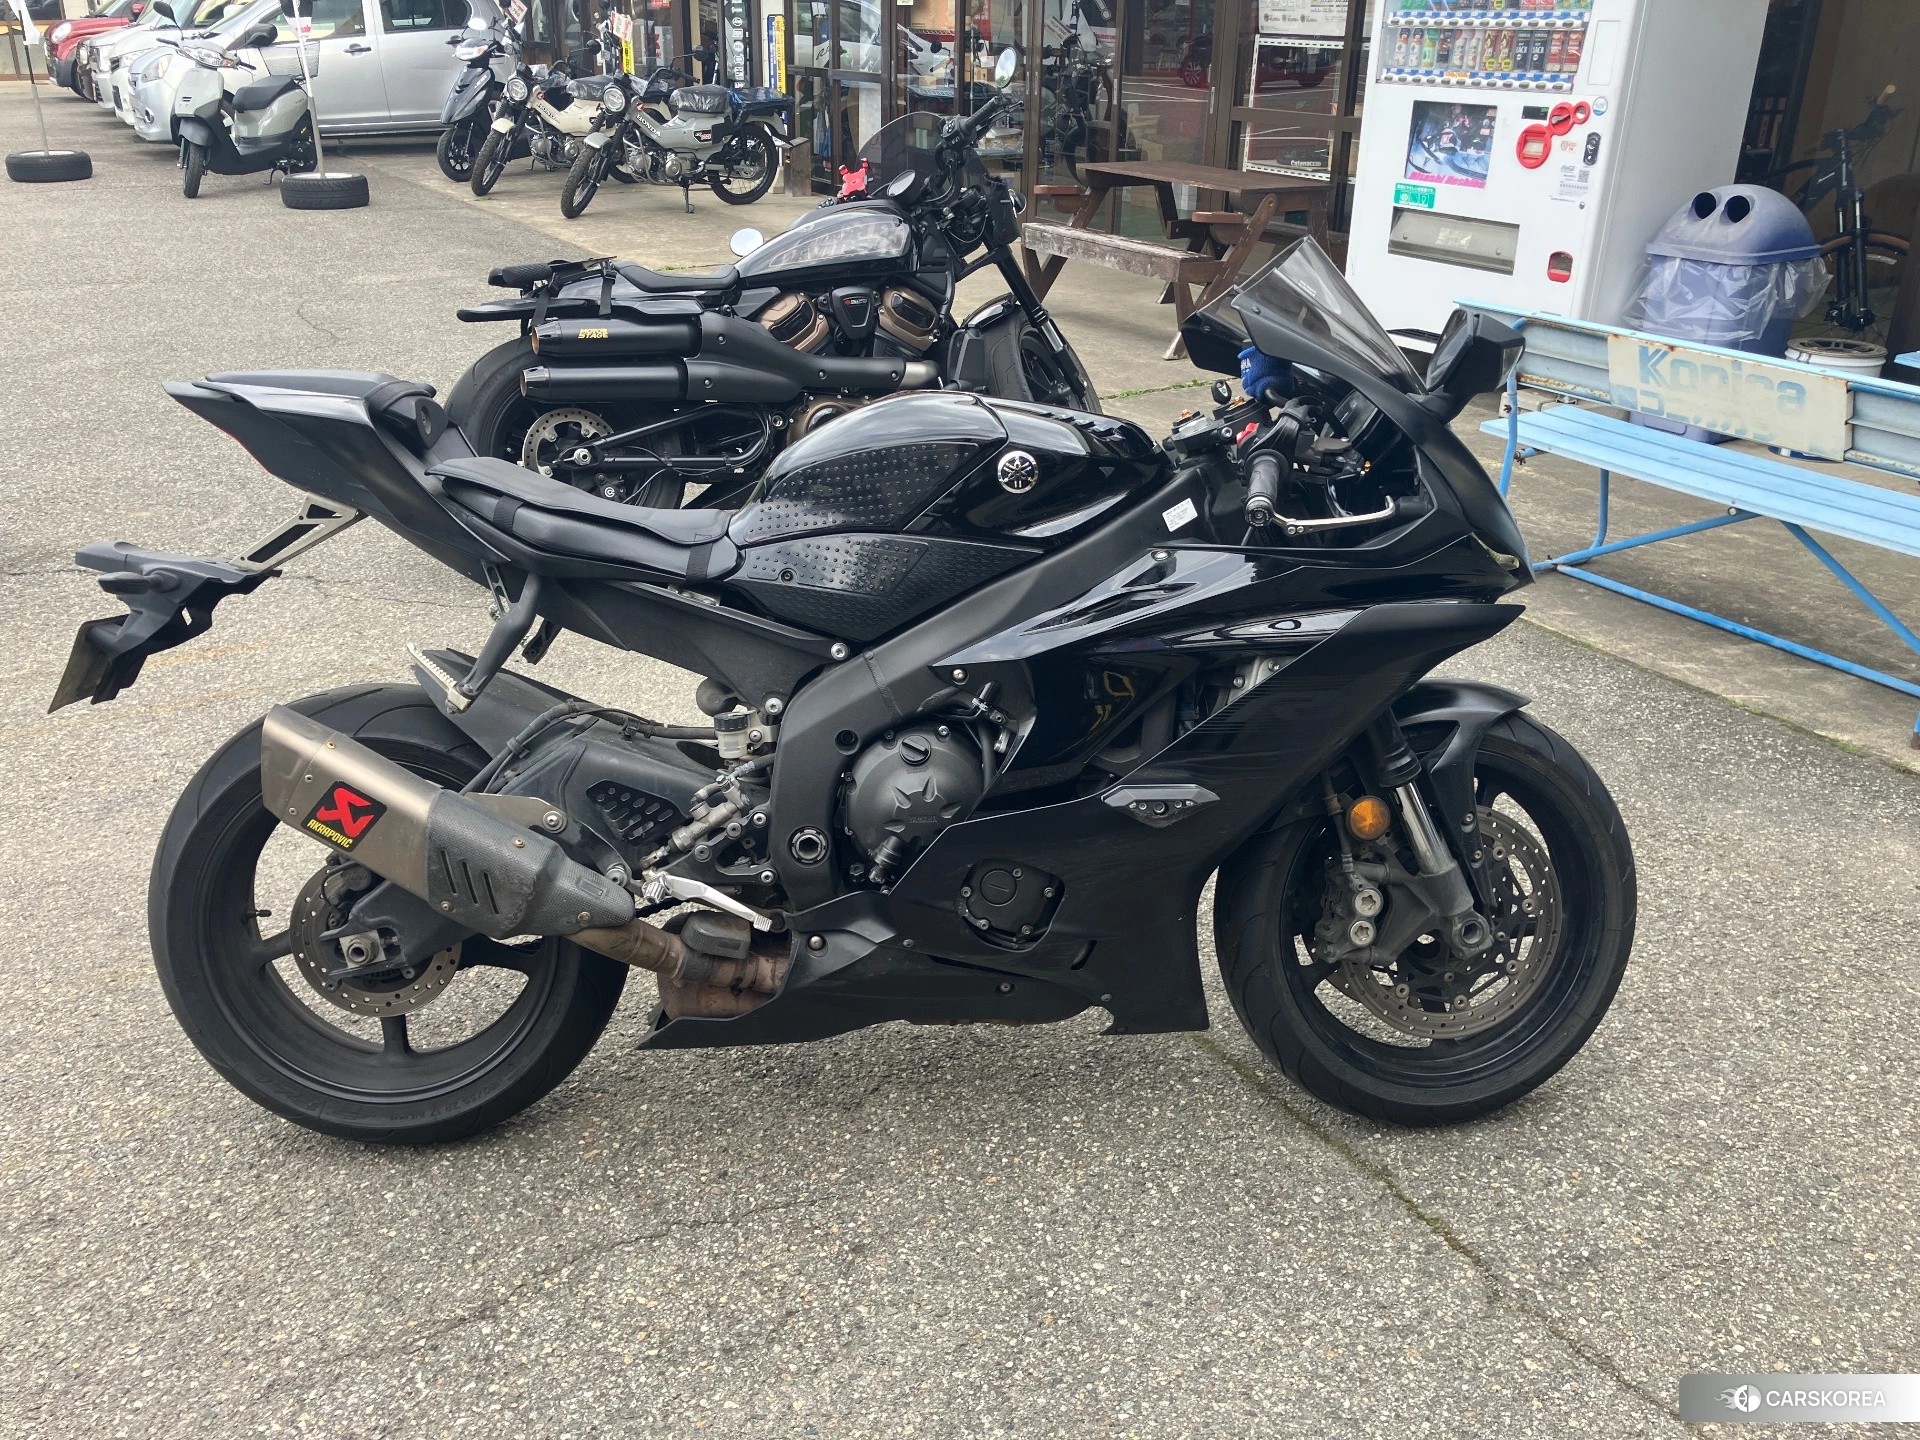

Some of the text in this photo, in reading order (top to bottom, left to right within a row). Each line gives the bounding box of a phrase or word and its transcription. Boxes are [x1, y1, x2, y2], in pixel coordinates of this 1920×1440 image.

[537, 102, 561, 123] HONDA
[636, 113, 662, 138] HONDA
[1638, 344, 1807, 416] Konica
[908, 815, 938, 824] YAMAHA
[306, 819, 354, 848] AKRAPOVIC
